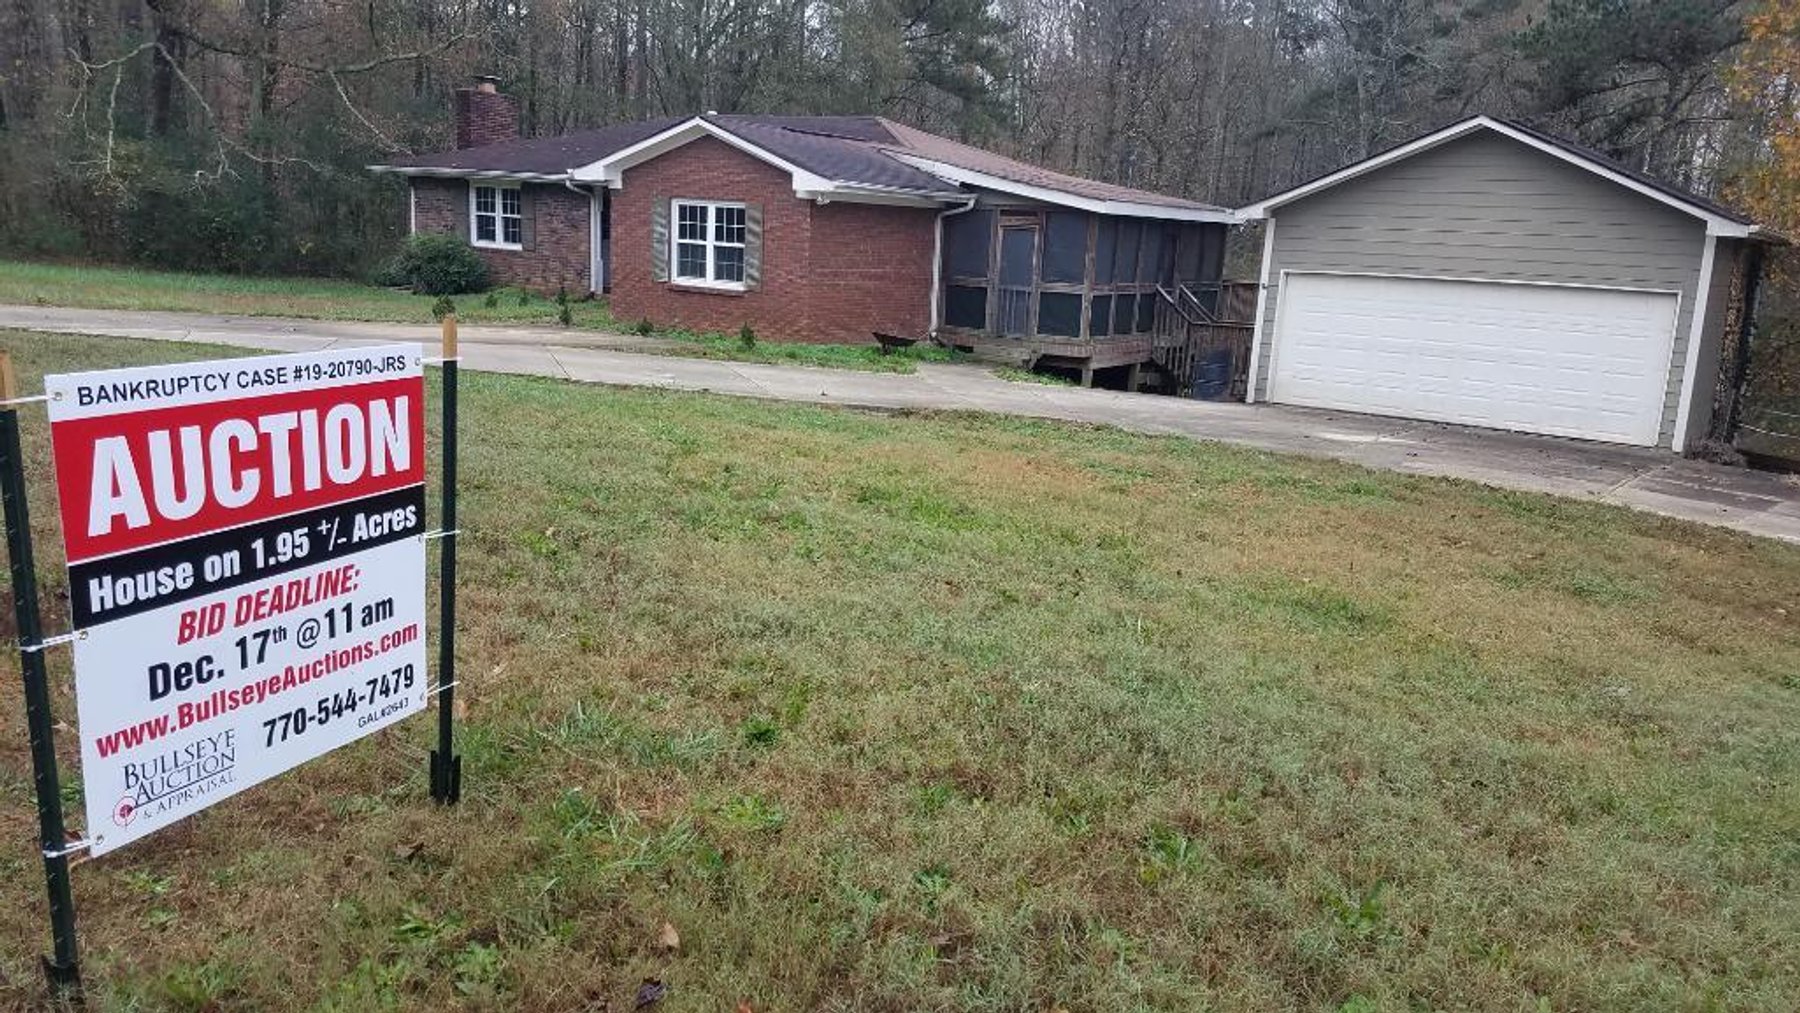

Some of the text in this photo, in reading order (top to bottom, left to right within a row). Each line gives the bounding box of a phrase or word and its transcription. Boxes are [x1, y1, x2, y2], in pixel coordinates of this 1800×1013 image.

[77, 355, 406, 407] BANKRUPTCY CASE #19-20790-JRS
[88, 395, 411, 538] AUCTION
[89, 562, 195, 614] House
[203, 549, 241, 582] on
[251, 527, 311, 569] 1.95
[352, 504, 418, 543] Acres
[177, 563, 362, 645] BID DEADLINE:
[96, 623, 418, 759] www.BullseyeAuctions.com
[148, 653, 225, 701] Dec.
[235, 622, 287, 671] 17th
[263, 663, 414, 748] 770-544-7479
[123, 728, 236, 790] BULLSEYE
[135, 747, 236, 807] AUCTION
[156, 771, 237, 815] APPRAISAL
